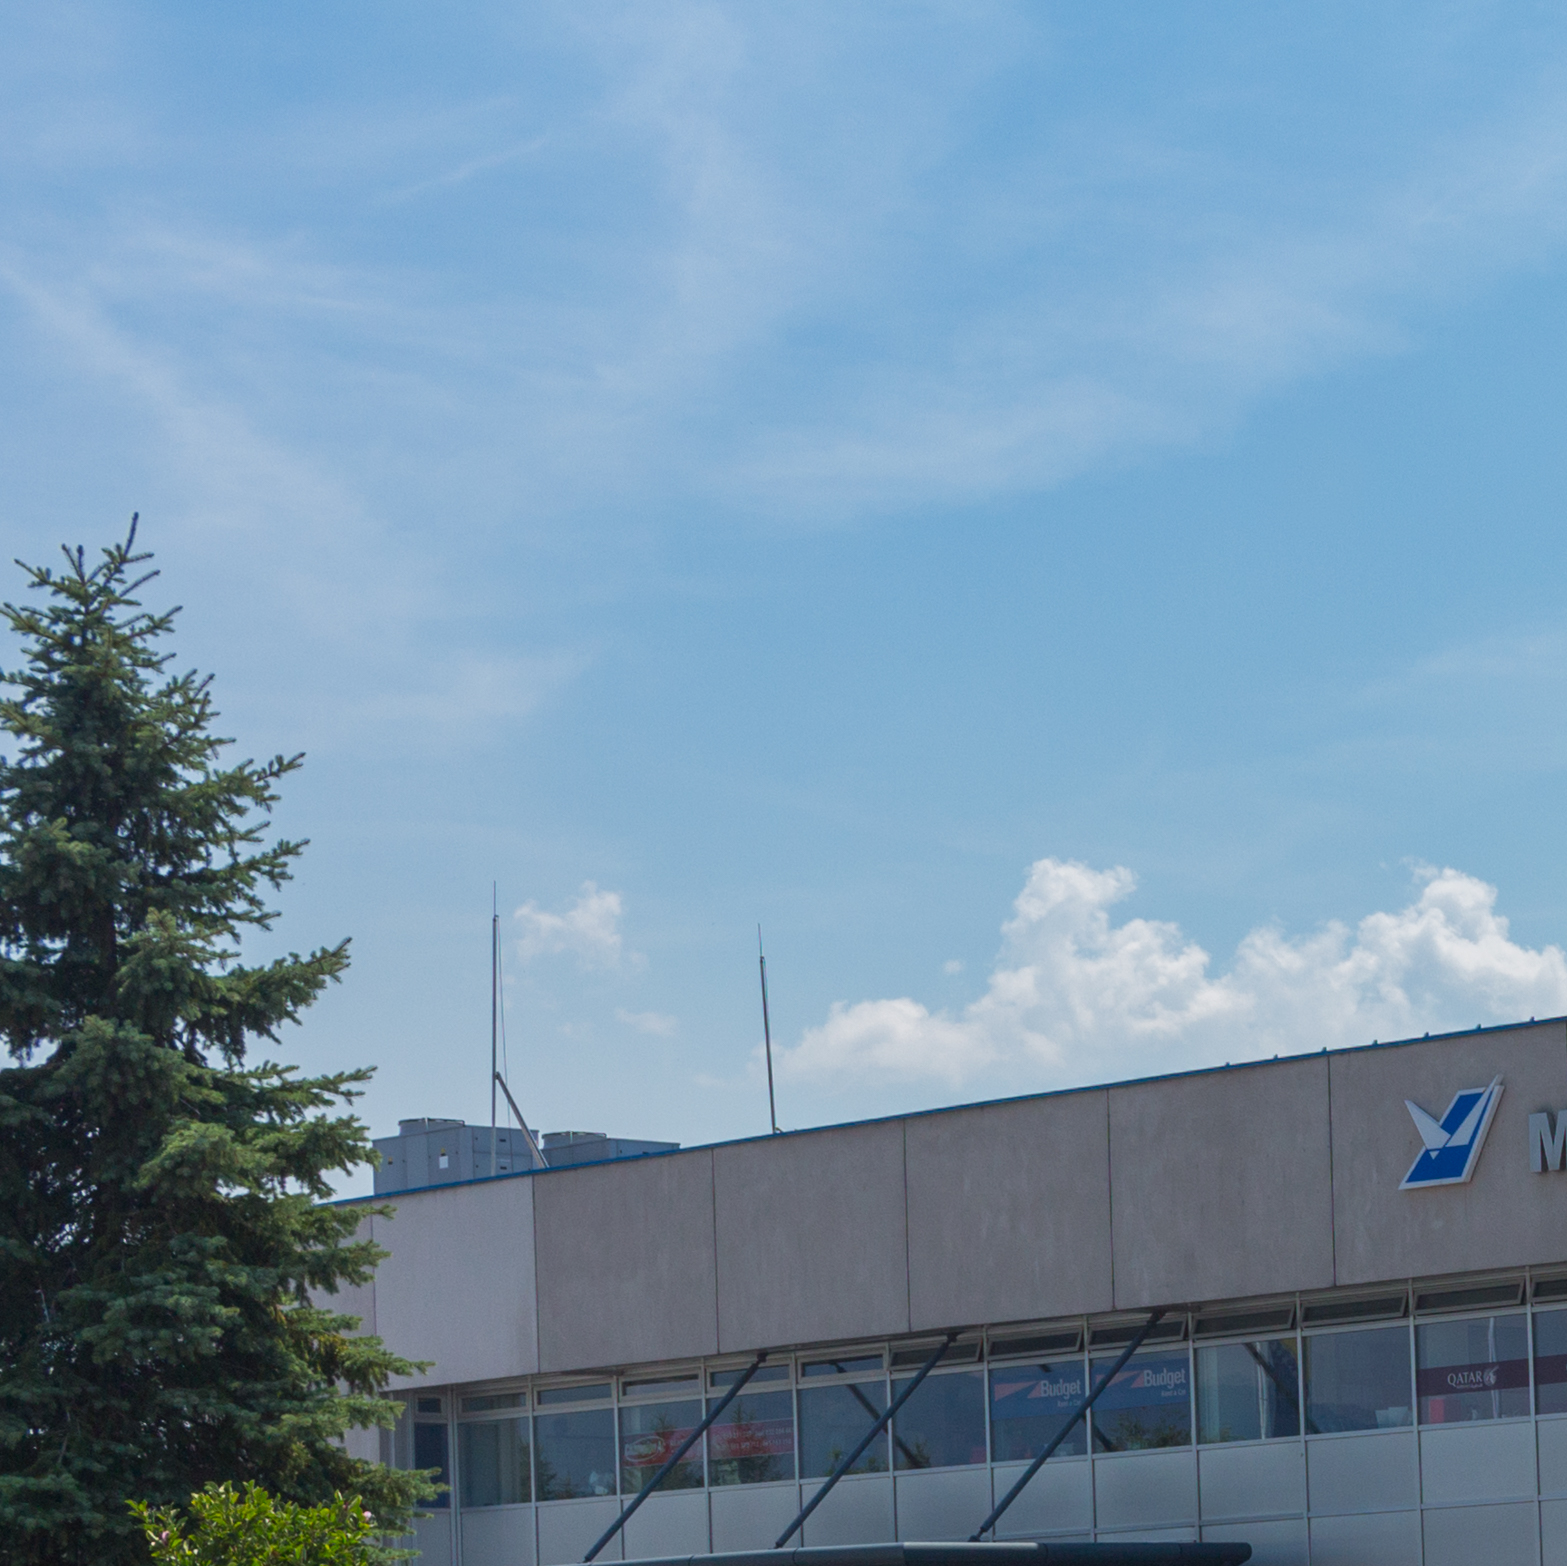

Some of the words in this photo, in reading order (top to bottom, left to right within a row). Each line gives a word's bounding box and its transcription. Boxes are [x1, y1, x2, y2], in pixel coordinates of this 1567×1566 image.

[1143, 1367, 1186, 1388] Budget
[1447, 1370, 1483, 1387] QATAR
[1040, 1379, 1081, 1399] Budget
